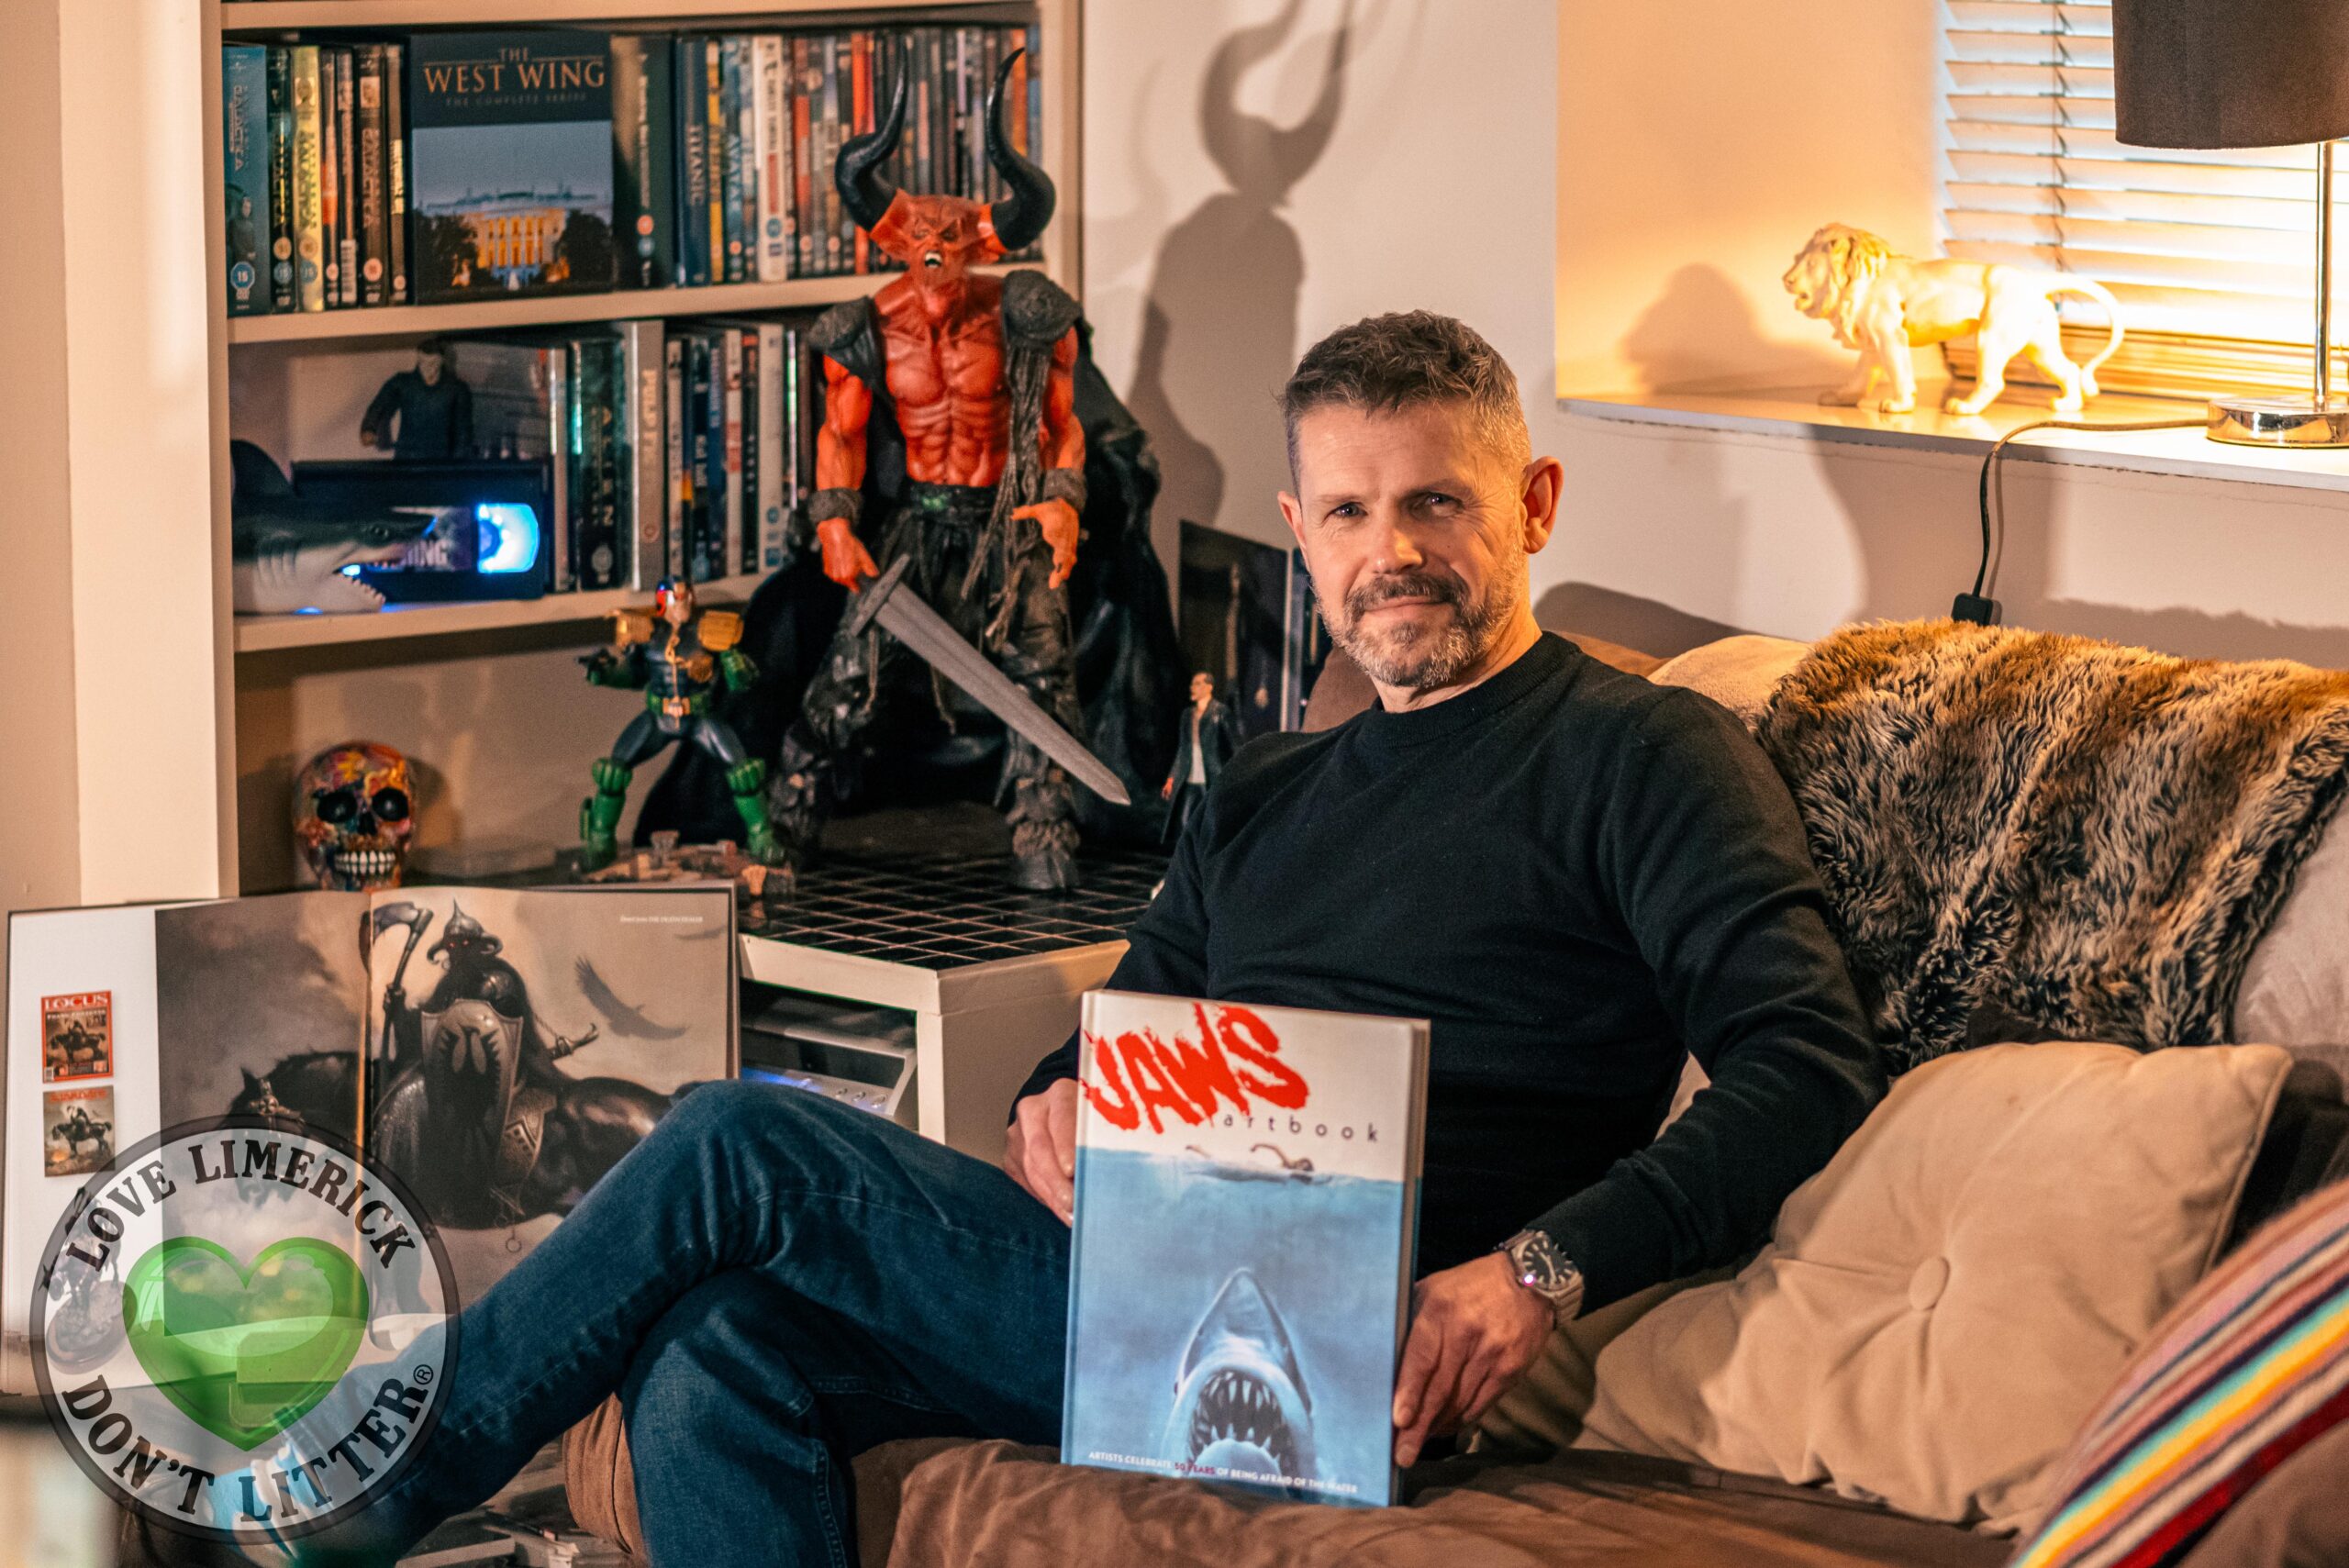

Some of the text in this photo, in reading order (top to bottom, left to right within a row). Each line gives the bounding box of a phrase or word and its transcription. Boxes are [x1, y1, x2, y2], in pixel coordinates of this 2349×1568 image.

[500, 47, 529, 61] THE
[424, 61, 606, 94] WEST WING
[688, 125, 706, 206] TITANIC
[45, 995, 108, 1010] LOCUS
[1080, 1002, 1309, 1135] JAWS
[1224, 1114, 1378, 1142] artbook
[1088, 1451, 1123, 1463] ARTISTS
[1124, 1455, 1173, 1468] CELEBRATE
[1217, 1467, 1230, 1477] OF
[1230, 1469, 1258, 1481] BEING
[1260, 1473, 1293, 1486] AFRAID
[1294, 1476, 1307, 1487] OF
